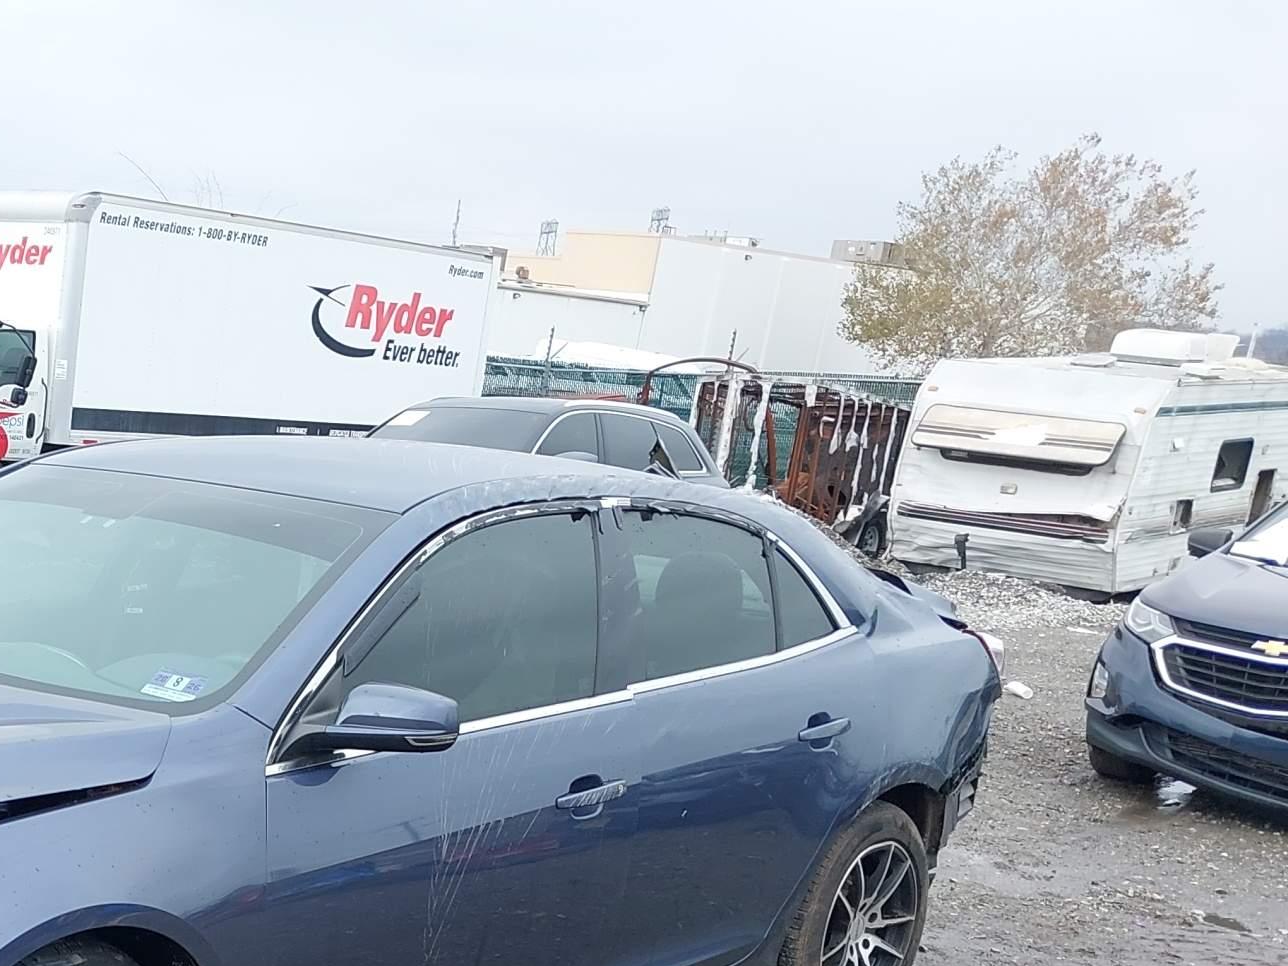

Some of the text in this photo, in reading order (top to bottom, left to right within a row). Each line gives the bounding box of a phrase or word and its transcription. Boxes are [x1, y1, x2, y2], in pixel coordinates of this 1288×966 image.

[99, 211, 269, 247] Rental Reservations: 1-800-BY-RYDER
[448, 264, 484, 280] Ryder.com
[345, 283, 455, 343] Ryder
[382, 339, 460, 368] Ever better.
[172, 676, 184, 688] 8
[186, 682, 202, 692] 26
